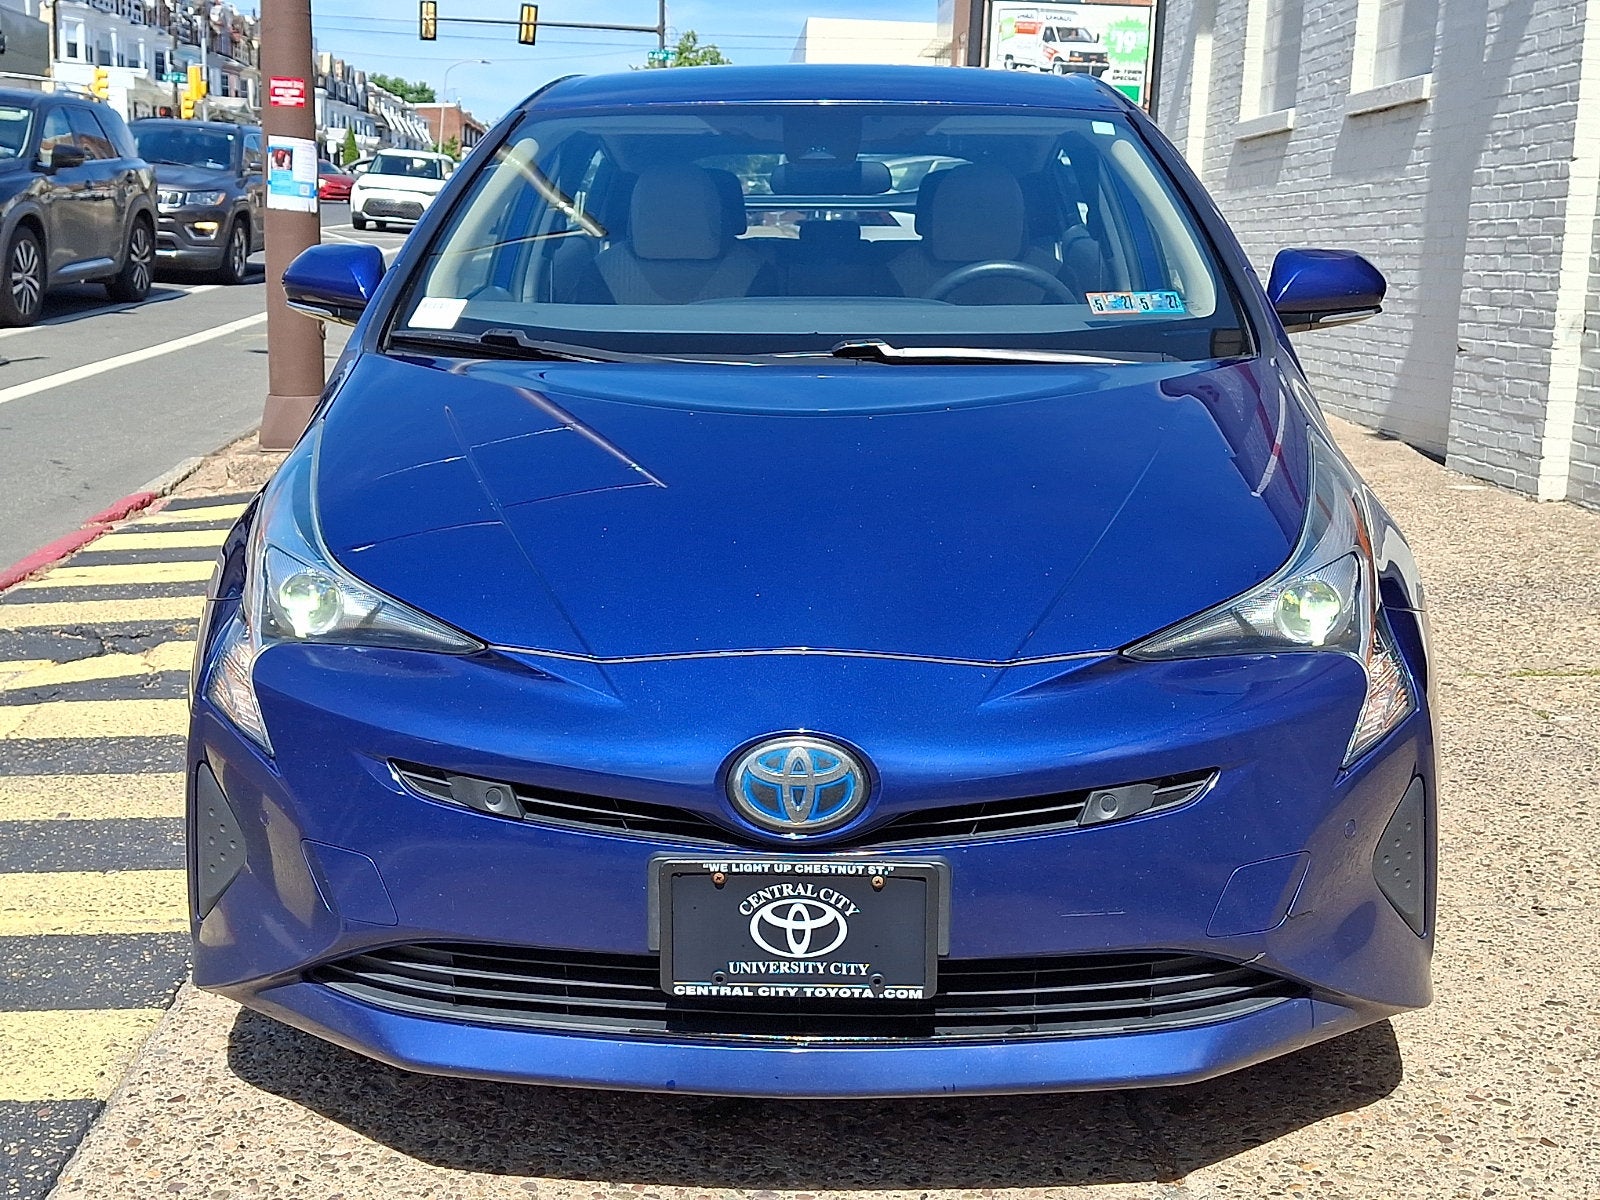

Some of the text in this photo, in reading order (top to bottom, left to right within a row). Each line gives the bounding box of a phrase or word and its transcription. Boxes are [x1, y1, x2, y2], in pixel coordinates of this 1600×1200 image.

[1094, 299, 1104, 311] 5
[1140, 297, 1150, 311] 5
[731, 863, 770, 873] LIGHT
[774, 863, 792, 873] UP
[794, 864, 865, 875] CHESTNUT
[739, 883, 861, 917] CENTRAL CITY
[728, 961, 871, 976] UNIVERSITY CITY
[673, 985, 923, 999] CENTRAL CITY TOYOTA .COM
